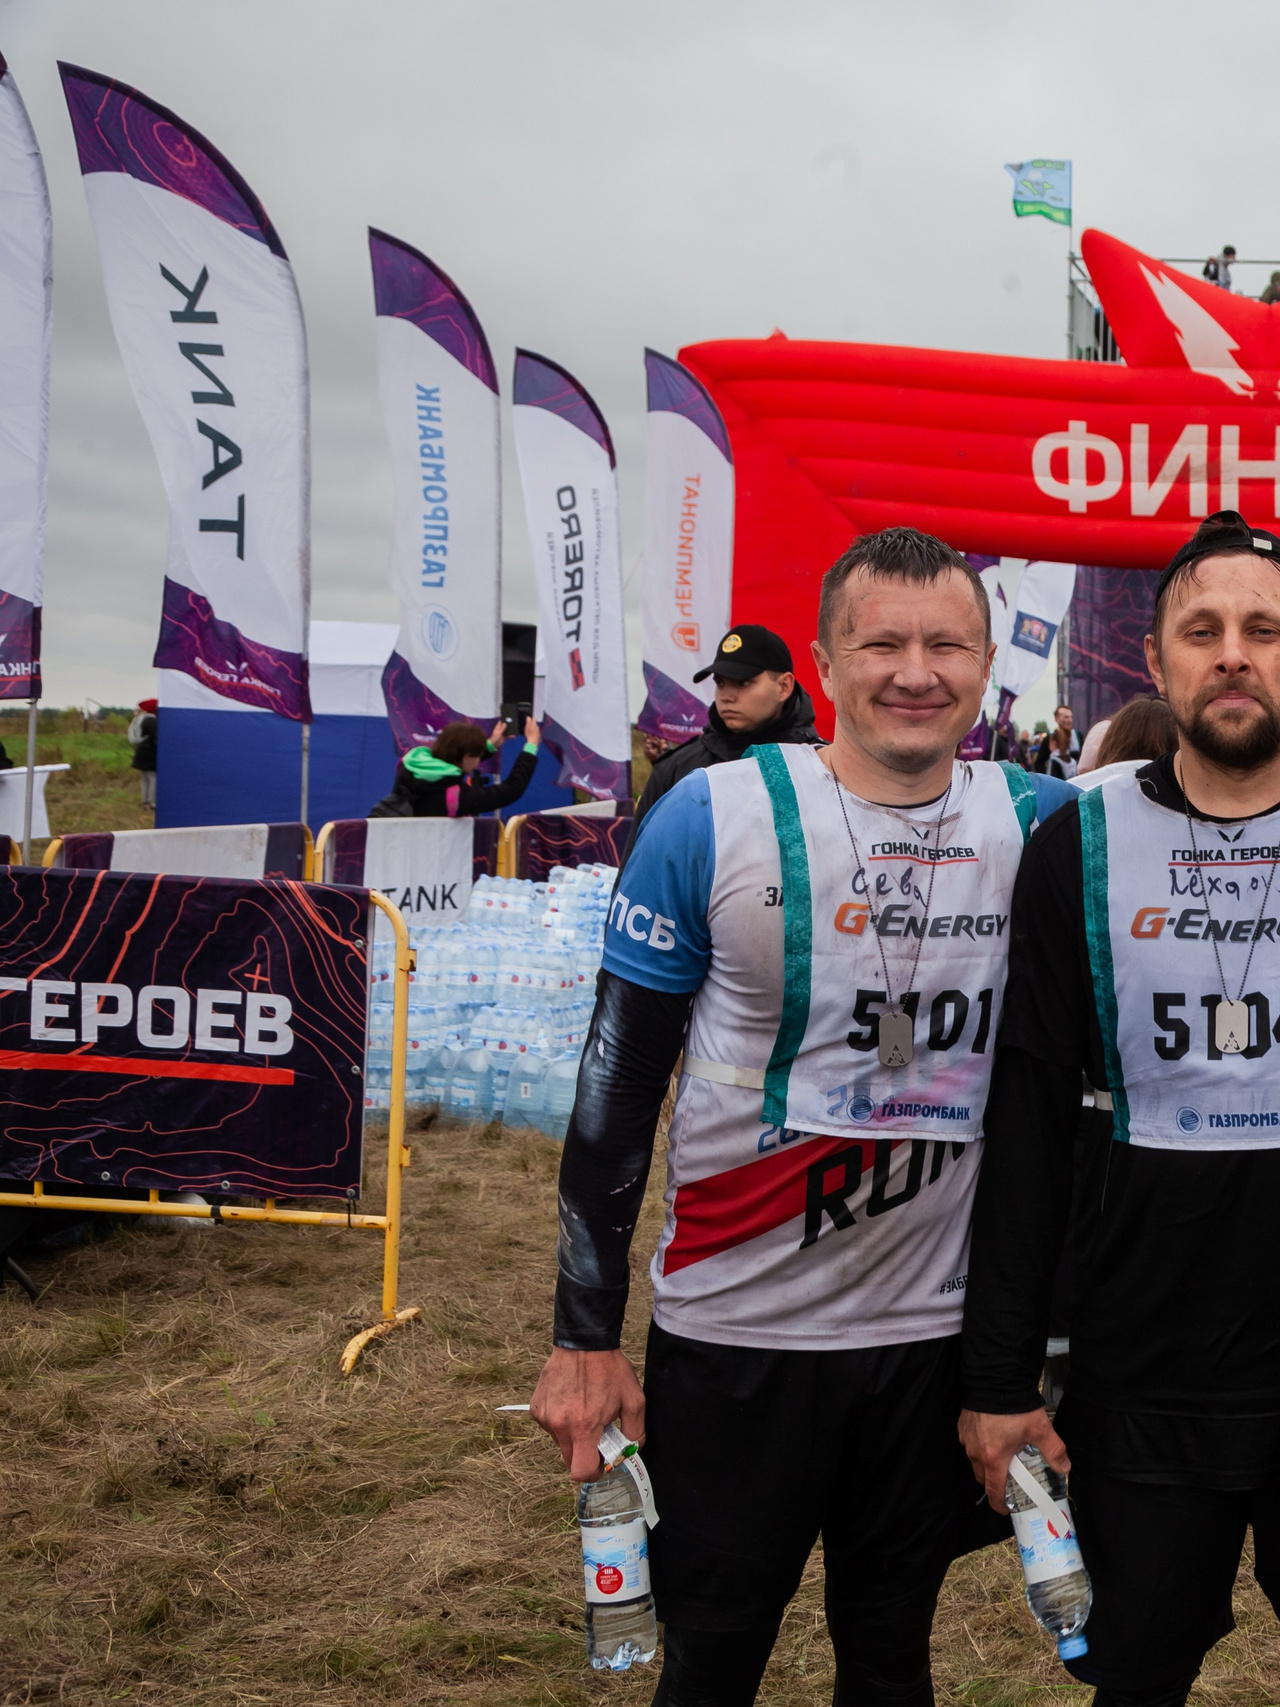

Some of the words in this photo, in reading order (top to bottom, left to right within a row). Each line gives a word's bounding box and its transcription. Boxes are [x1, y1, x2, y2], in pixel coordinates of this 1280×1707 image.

[871, 842, 920, 859] ГОНКА
[921, 846, 975, 860] ГЕРОЕВ
[1171, 849, 1226, 862] ГОНКА
[381, 882, 459, 913] TANK
[608, 891, 676, 951] ПСБ
[881, 1103, 970, 1121] ГАЗПРОМБАНК
